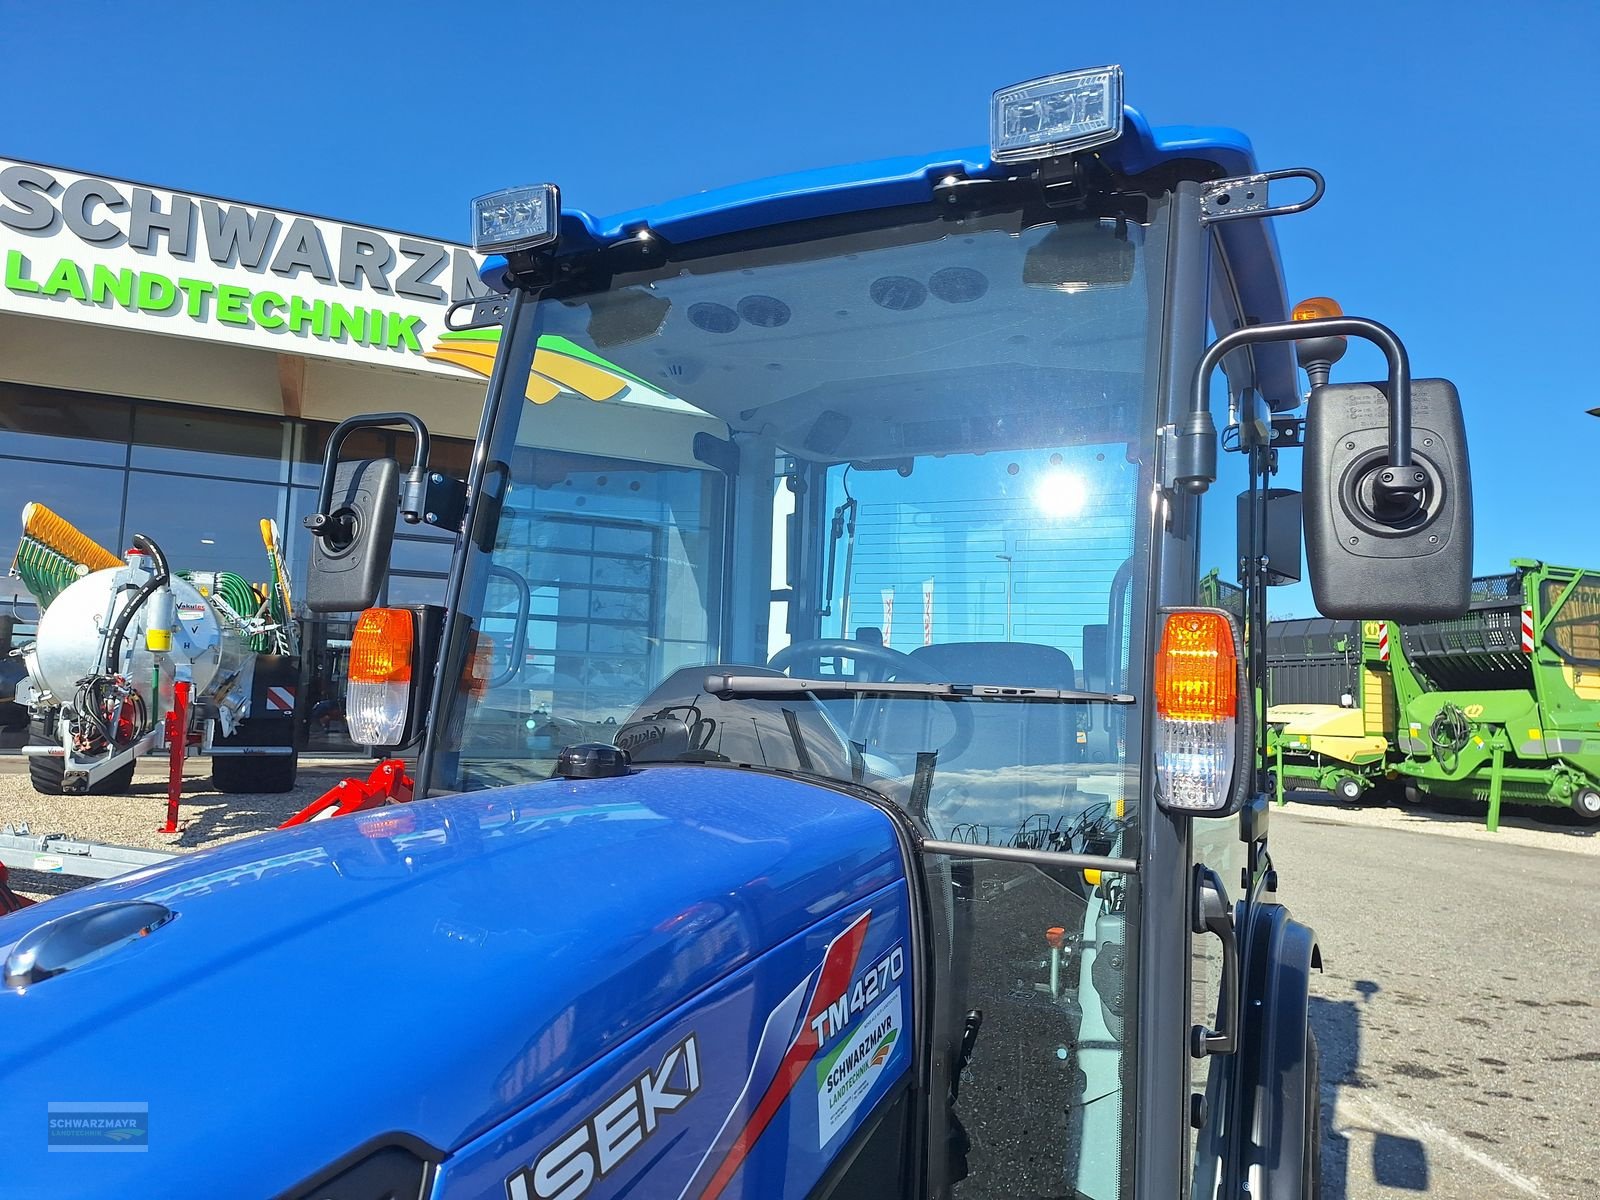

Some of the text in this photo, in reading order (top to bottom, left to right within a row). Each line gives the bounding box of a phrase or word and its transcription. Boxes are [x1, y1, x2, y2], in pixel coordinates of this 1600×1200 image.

[4, 250, 422, 352] LANDTECHNIK
[811, 945, 905, 1048] TM4270
[827, 1015, 892, 1093] SCHWARZMAYR
[829, 1060, 870, 1109] LANDTECHNIK
